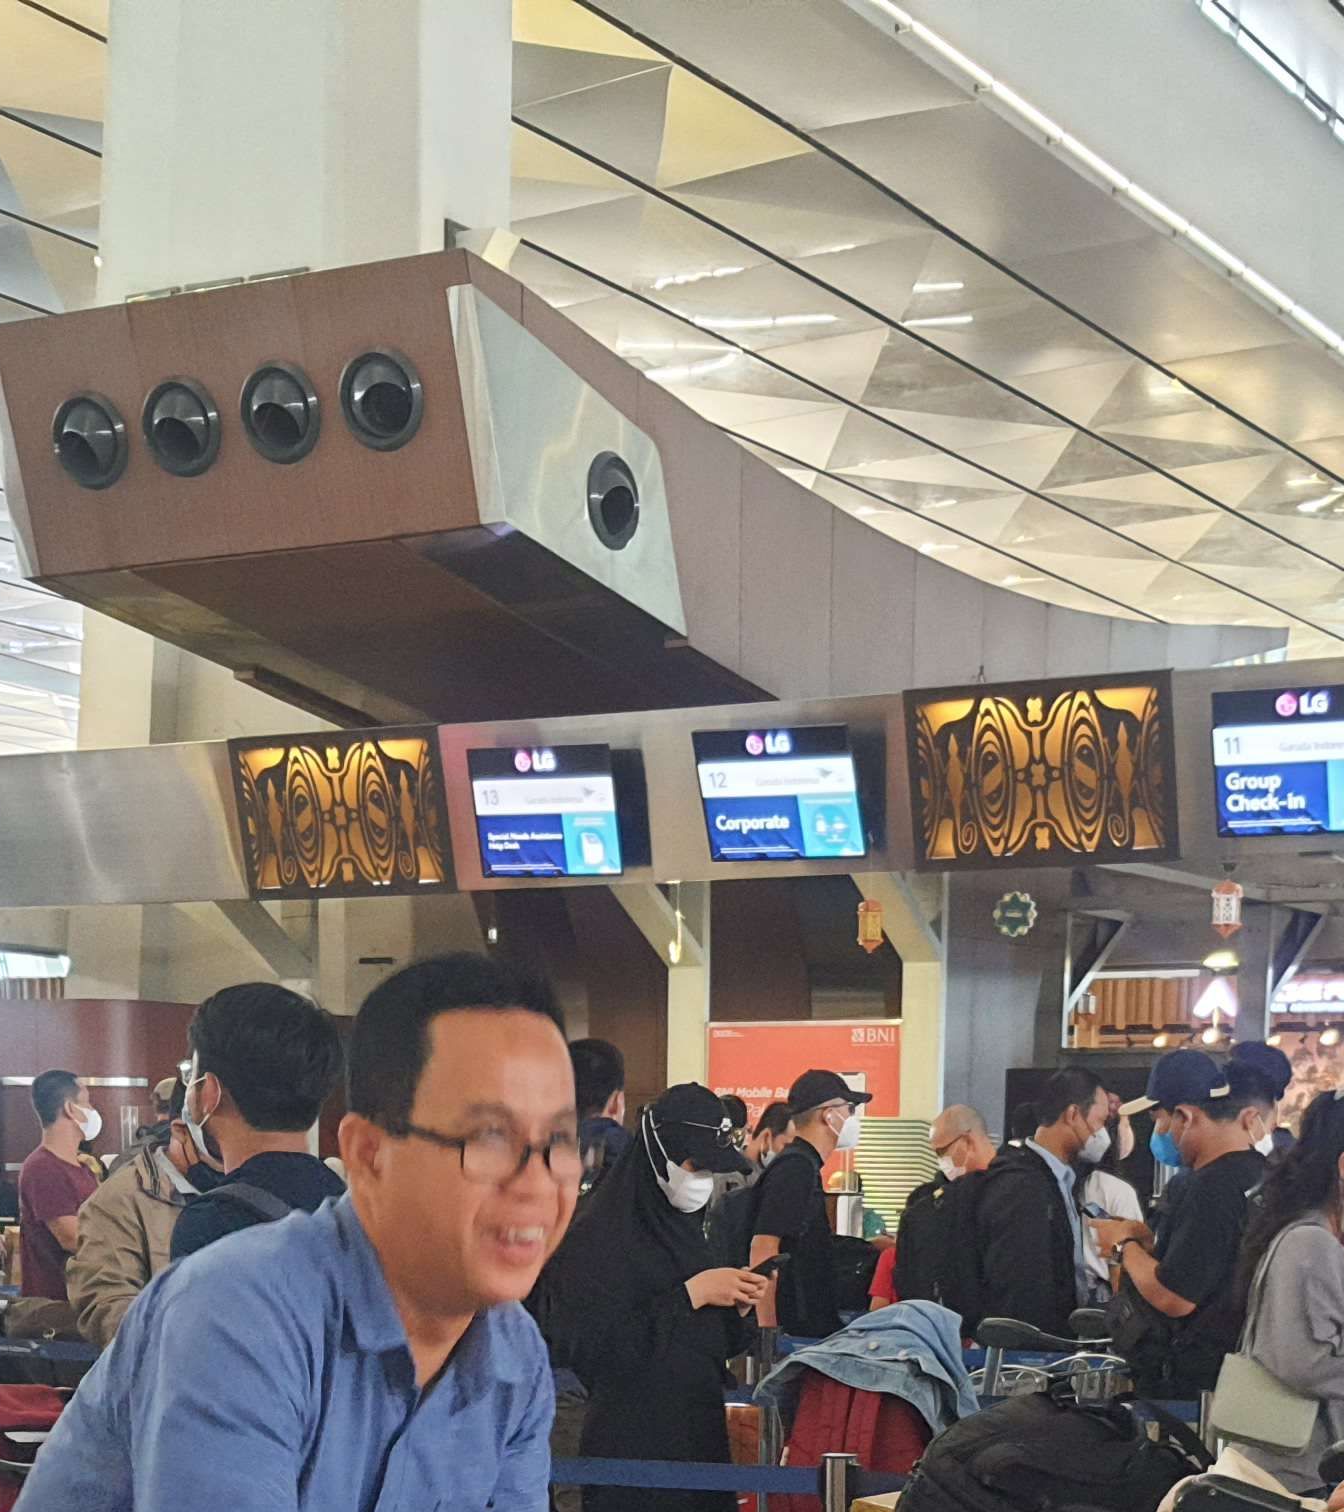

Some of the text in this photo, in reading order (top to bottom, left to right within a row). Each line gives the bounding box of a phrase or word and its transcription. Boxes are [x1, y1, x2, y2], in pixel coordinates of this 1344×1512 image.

[1299, 691, 1329, 715] LG
[765, 731, 792, 754] LG
[1223, 736, 1241, 755] 11
[531, 750, 556, 772] LG
[708, 771, 728, 789] 12
[1224, 772, 1282, 793] Group
[482, 789, 500, 806] 13
[1225, 792, 1306, 813] Check-in
[715, 814, 791, 835] Corporate
[867, 1028, 896, 1043] BNI
[736, 1086, 773, 1099] Mobile
